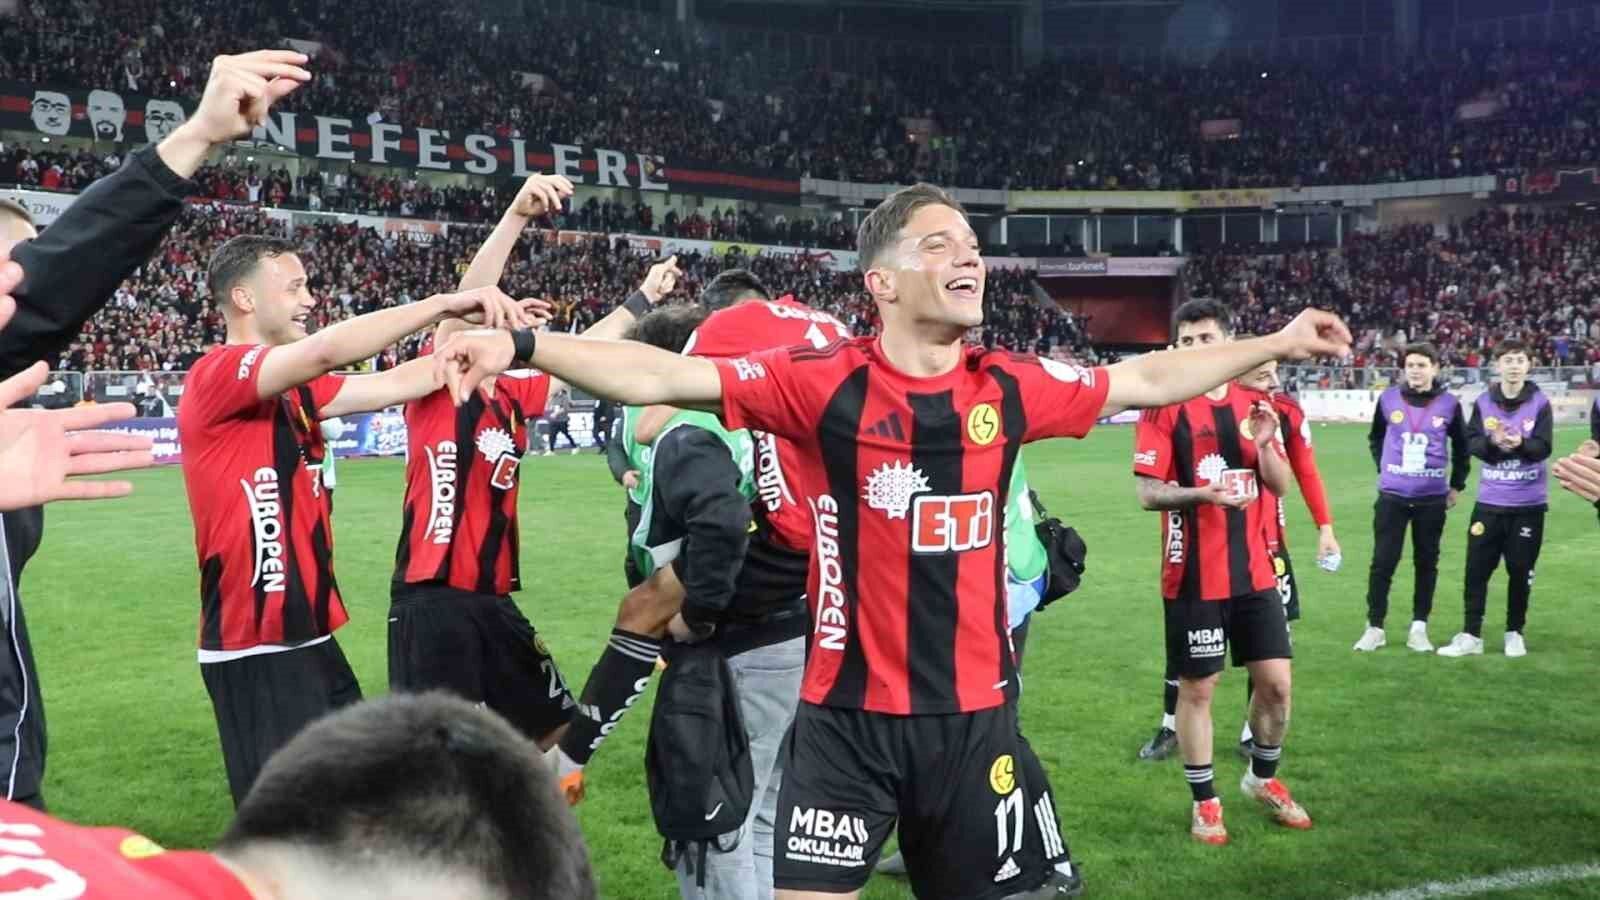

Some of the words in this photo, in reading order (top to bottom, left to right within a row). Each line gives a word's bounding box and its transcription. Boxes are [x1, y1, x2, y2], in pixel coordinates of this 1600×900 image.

[254, 466, 287, 593] EUROPEN
[433, 440, 458, 545] EUROPEN
[817, 494, 848, 651] EUROPEN
[789, 805, 856, 843] MBA
[994, 787, 1024, 857] 17
